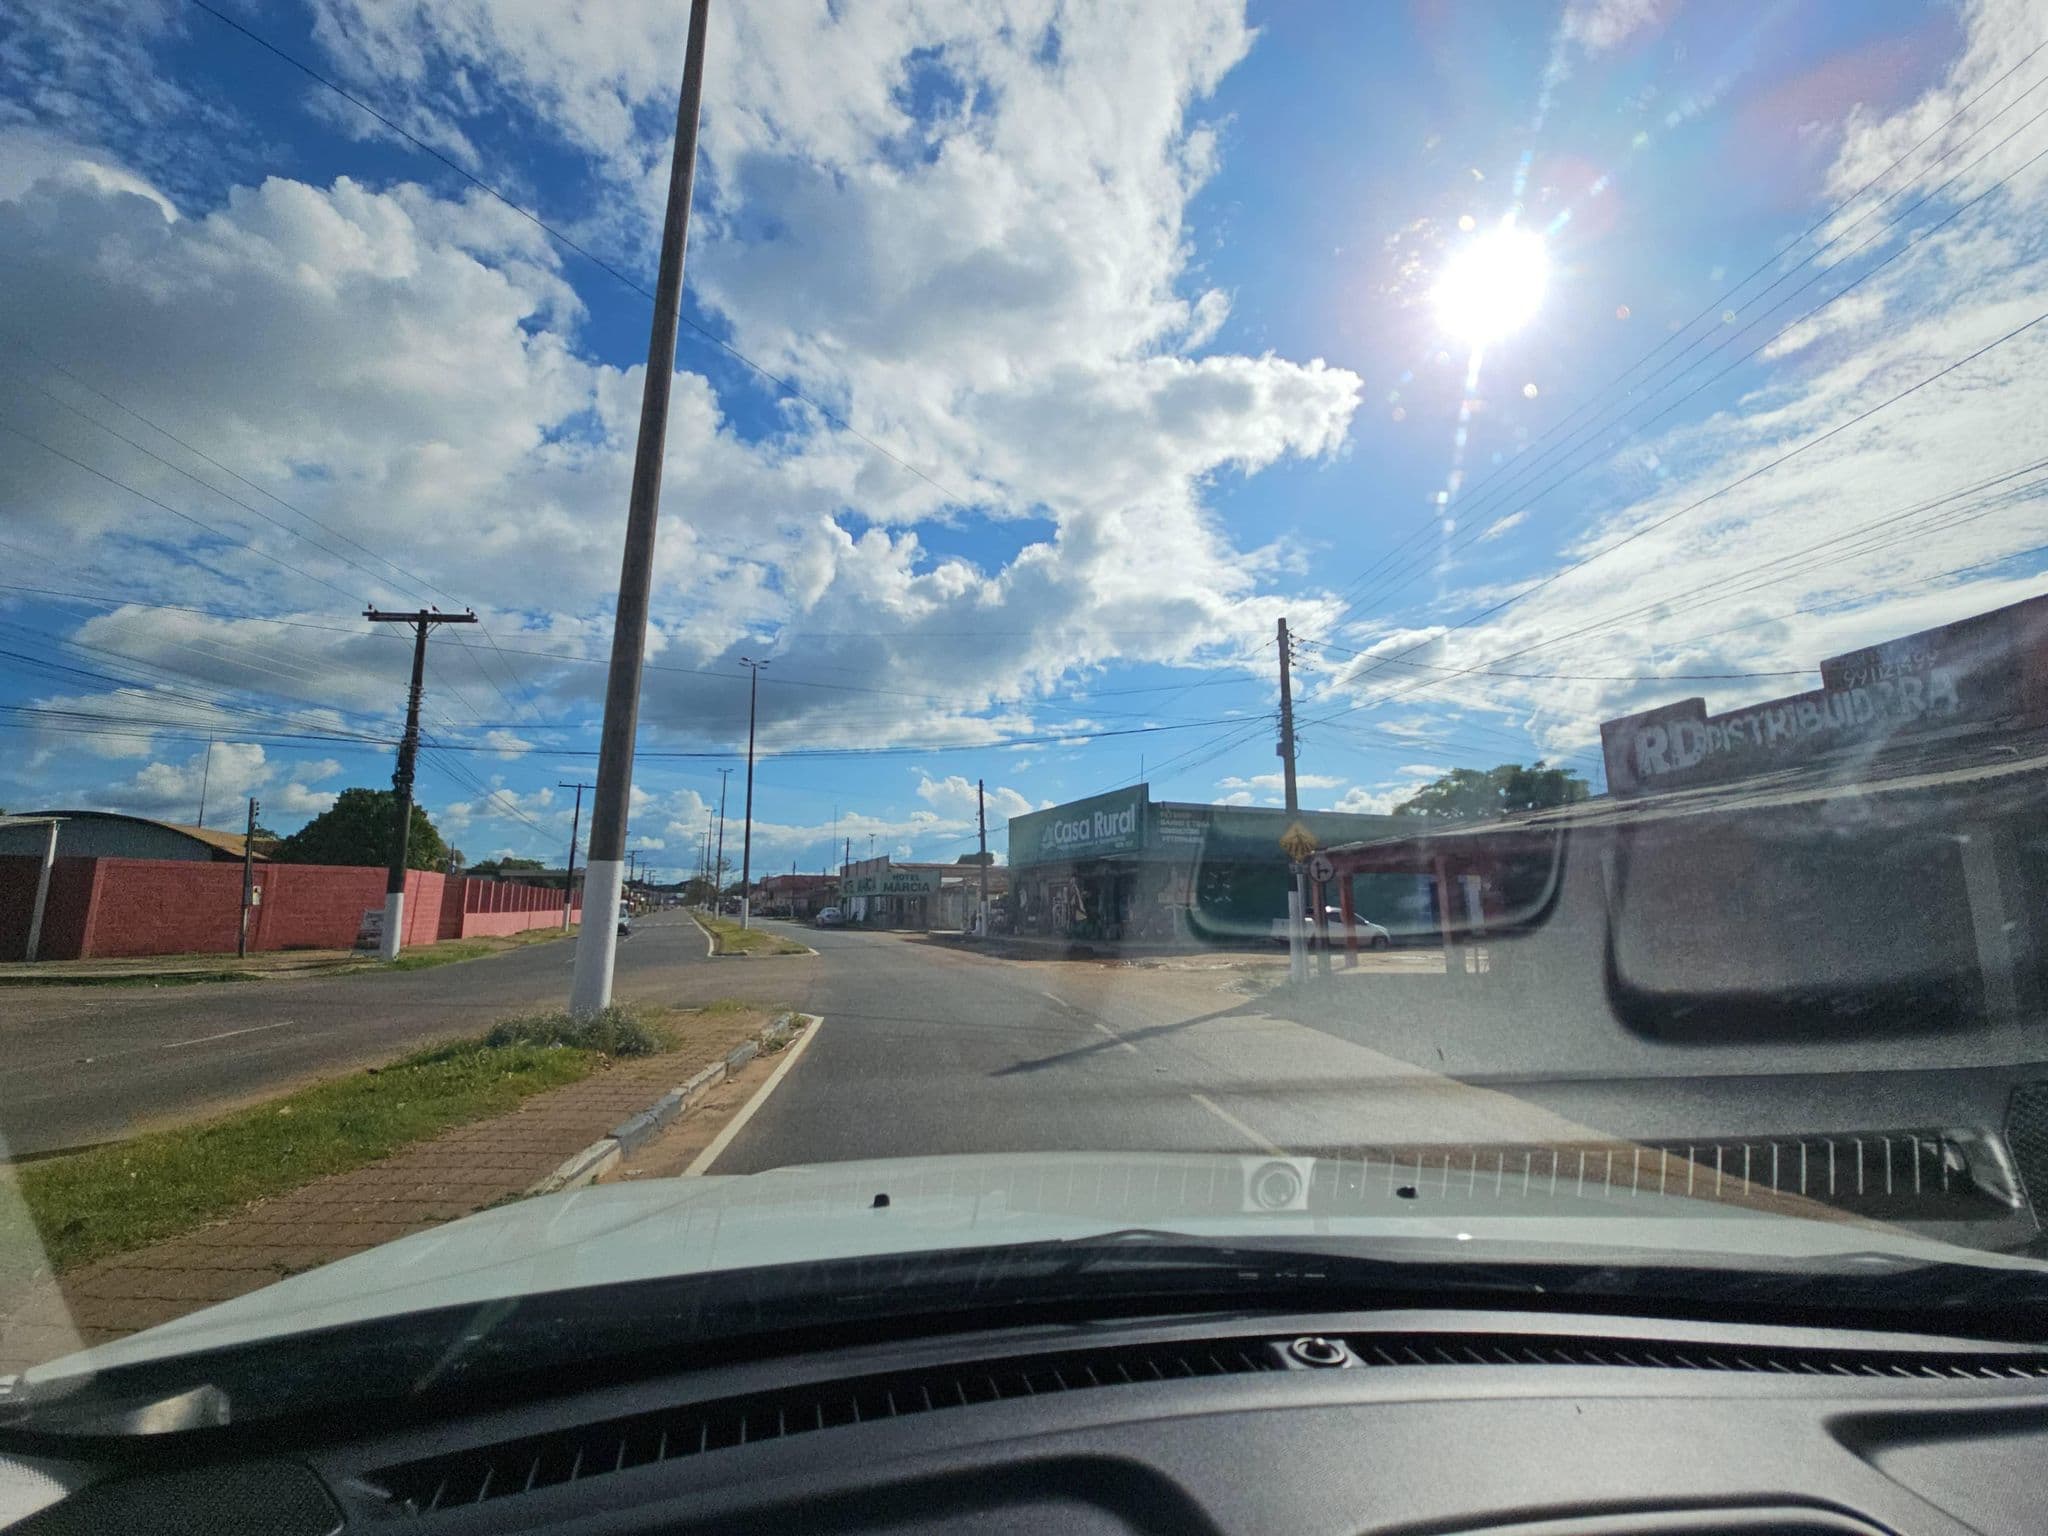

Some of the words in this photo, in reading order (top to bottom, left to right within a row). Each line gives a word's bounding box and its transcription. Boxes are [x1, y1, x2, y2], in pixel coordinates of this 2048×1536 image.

[1633, 718, 1704, 775] RD
[1054, 819, 1090, 844] Casa
[1094, 803, 1136, 838] Rural
